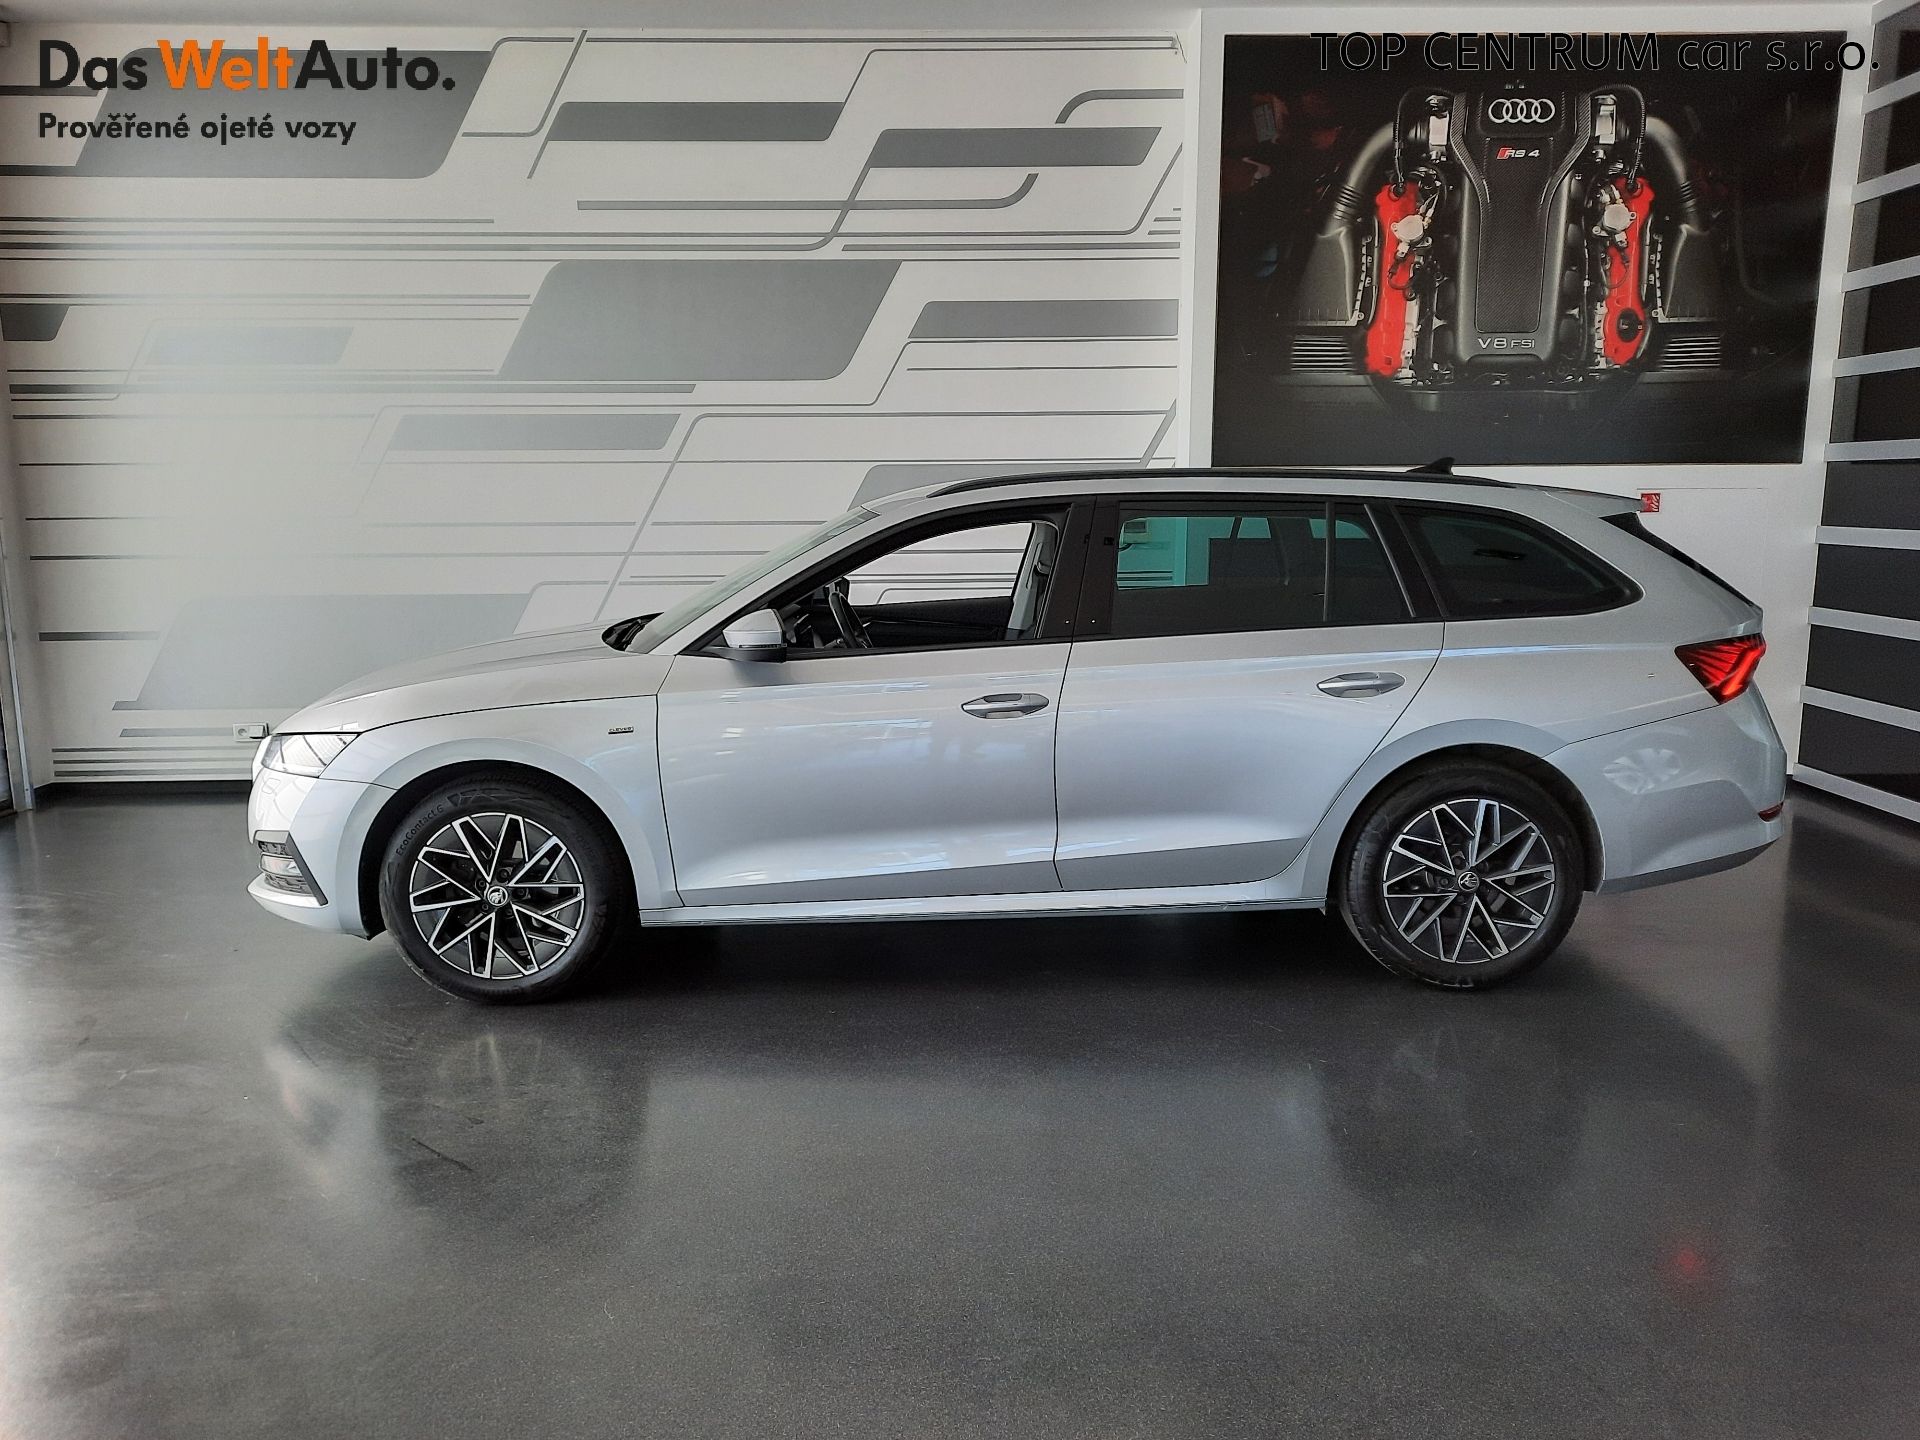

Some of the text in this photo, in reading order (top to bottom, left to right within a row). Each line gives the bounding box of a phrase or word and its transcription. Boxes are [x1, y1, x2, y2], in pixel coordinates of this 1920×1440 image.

[1477, 337, 1535, 349] V8 FSI
[395, 809, 437, 856] EcoContact
